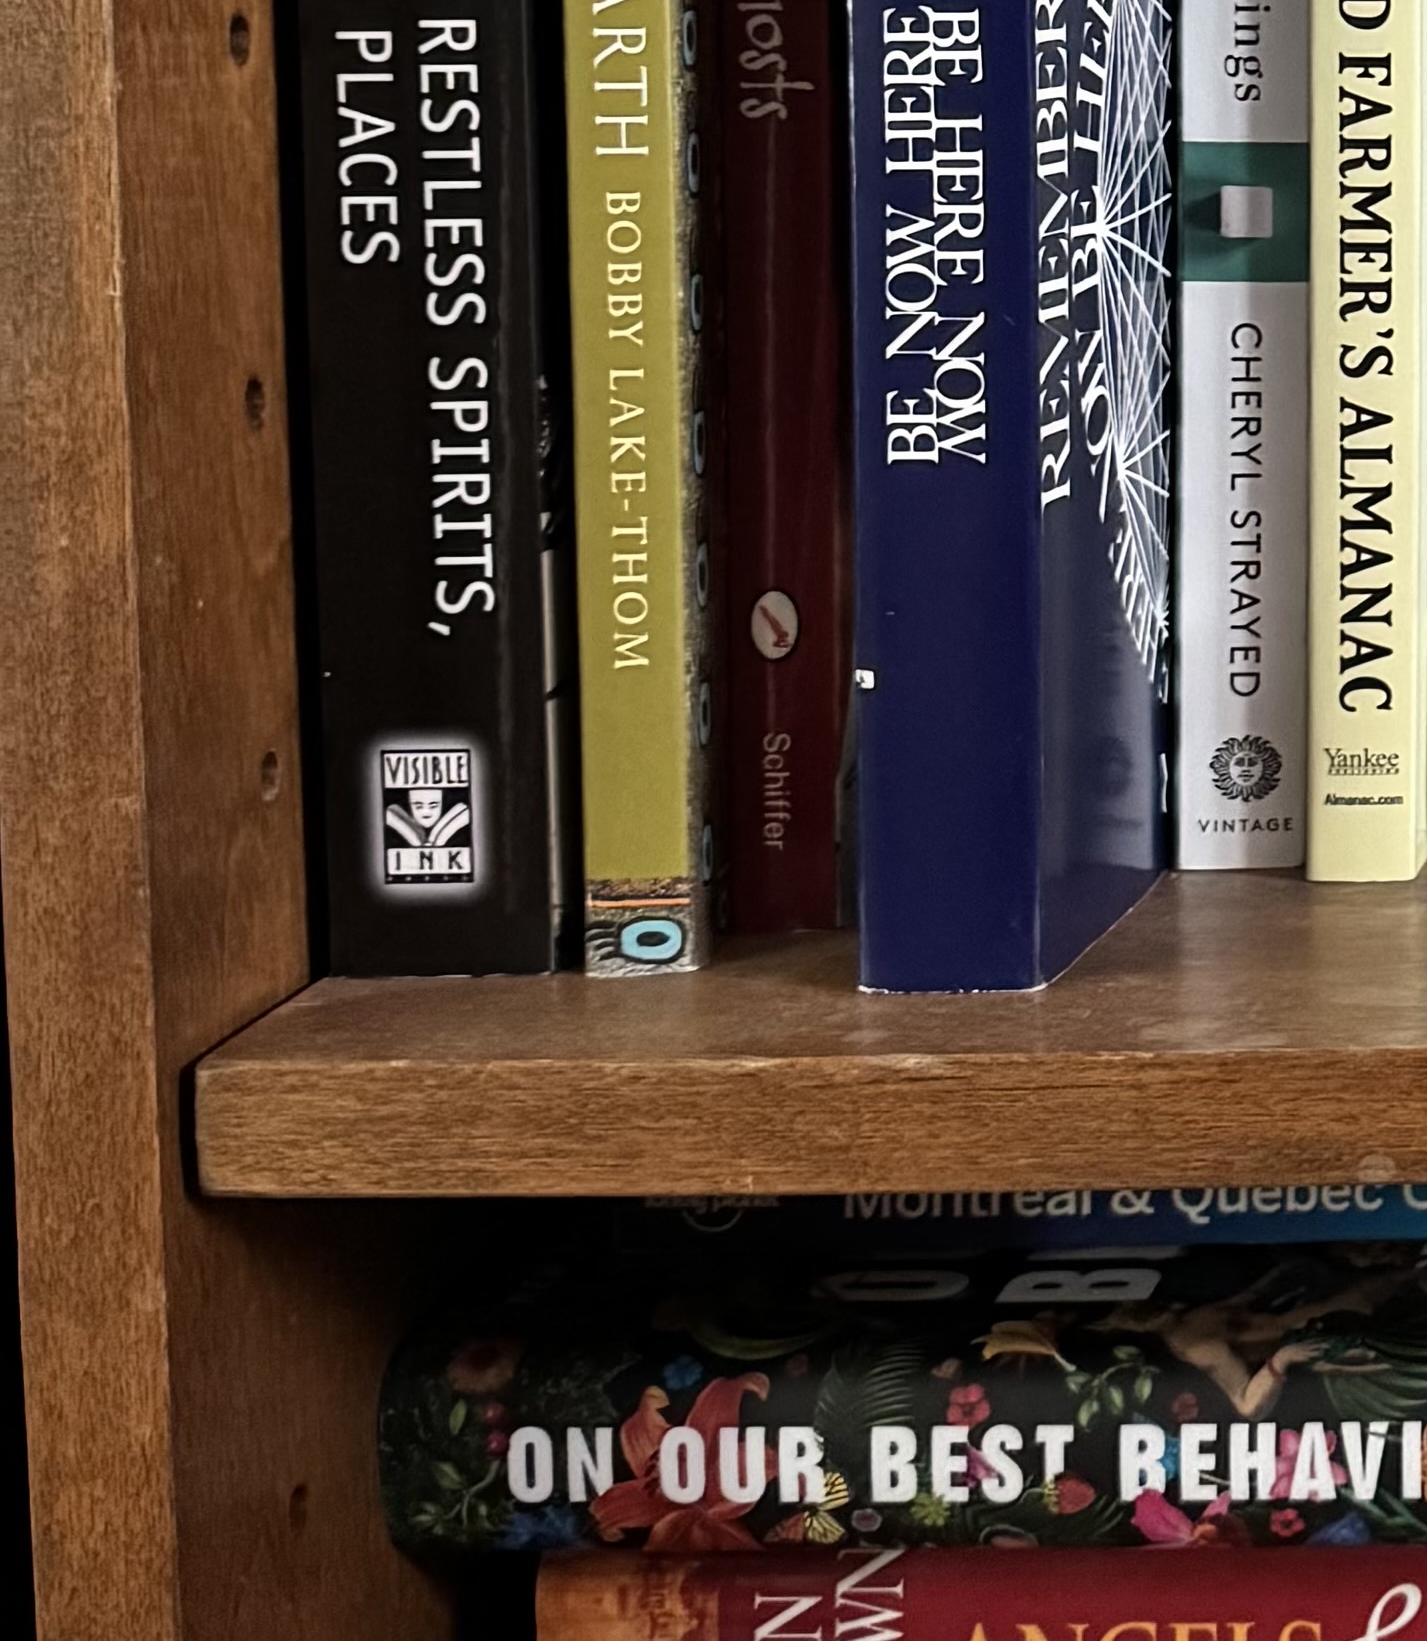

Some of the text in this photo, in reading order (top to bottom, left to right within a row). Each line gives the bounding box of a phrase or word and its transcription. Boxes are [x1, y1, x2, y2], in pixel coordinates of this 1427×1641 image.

[335, 30, 400, 264] PLACES
[417, 18, 487, 326] RESTLESS
[1338, 52, 1395, 379] FARMER'S
[427, 357, 496, 637] SPIRITS,
[605, 191, 651, 669] BOBBY LAKE-THOM
[1229, 322, 1263, 699] CHERYL STRAYED
[1338, 397, 1395, 714] ALMANAC
[385, 754, 468, 787] VISIBLE
[395, 850, 463, 872] INK
[761, 733, 791, 850] Schiffer
[1198, 817, 1294, 833] VINTAGE
[507, 1426, 613, 1503] ON
[658, 1426, 825, 1504] OUR
[870, 1424, 1074, 1504] BEST
